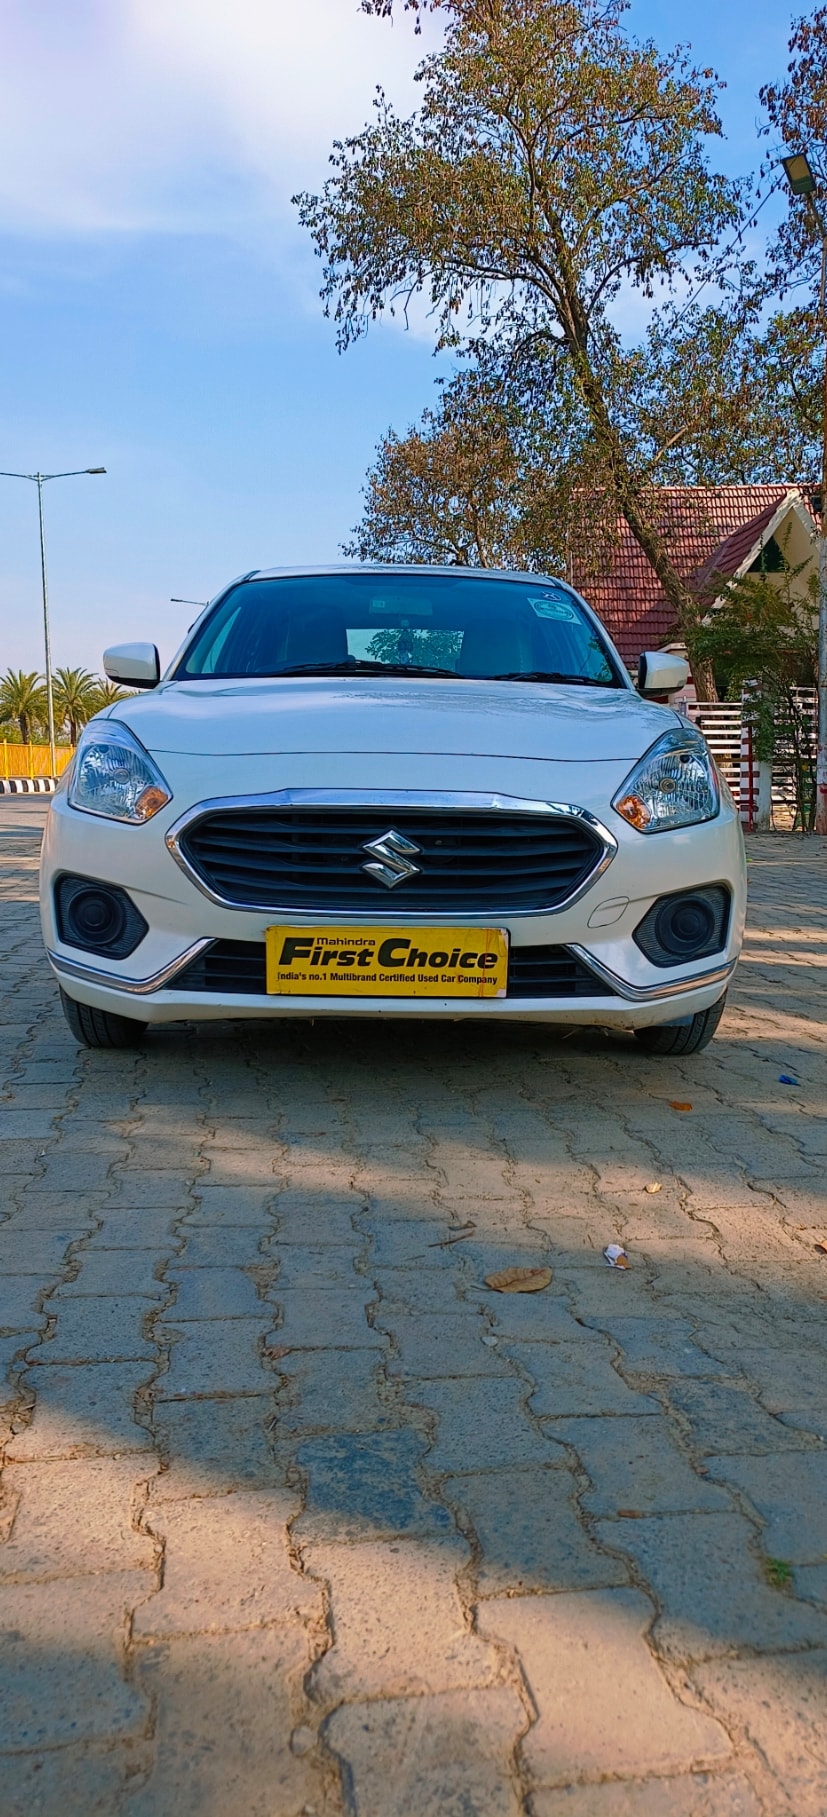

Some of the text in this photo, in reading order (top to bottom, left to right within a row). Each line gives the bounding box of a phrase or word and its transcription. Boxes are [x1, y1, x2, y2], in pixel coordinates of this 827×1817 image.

[317, 937, 376, 946] Mahindra
[278, 937, 498, 969] First Choice
[309, 973, 328, 981] no.1
[330, 972, 377, 982] Multibrand
[379, 973, 416, 982] Certified
[418, 974, 439, 983] Used
[441, 975, 455, 983] Car
[457, 975, 498, 985] Company
